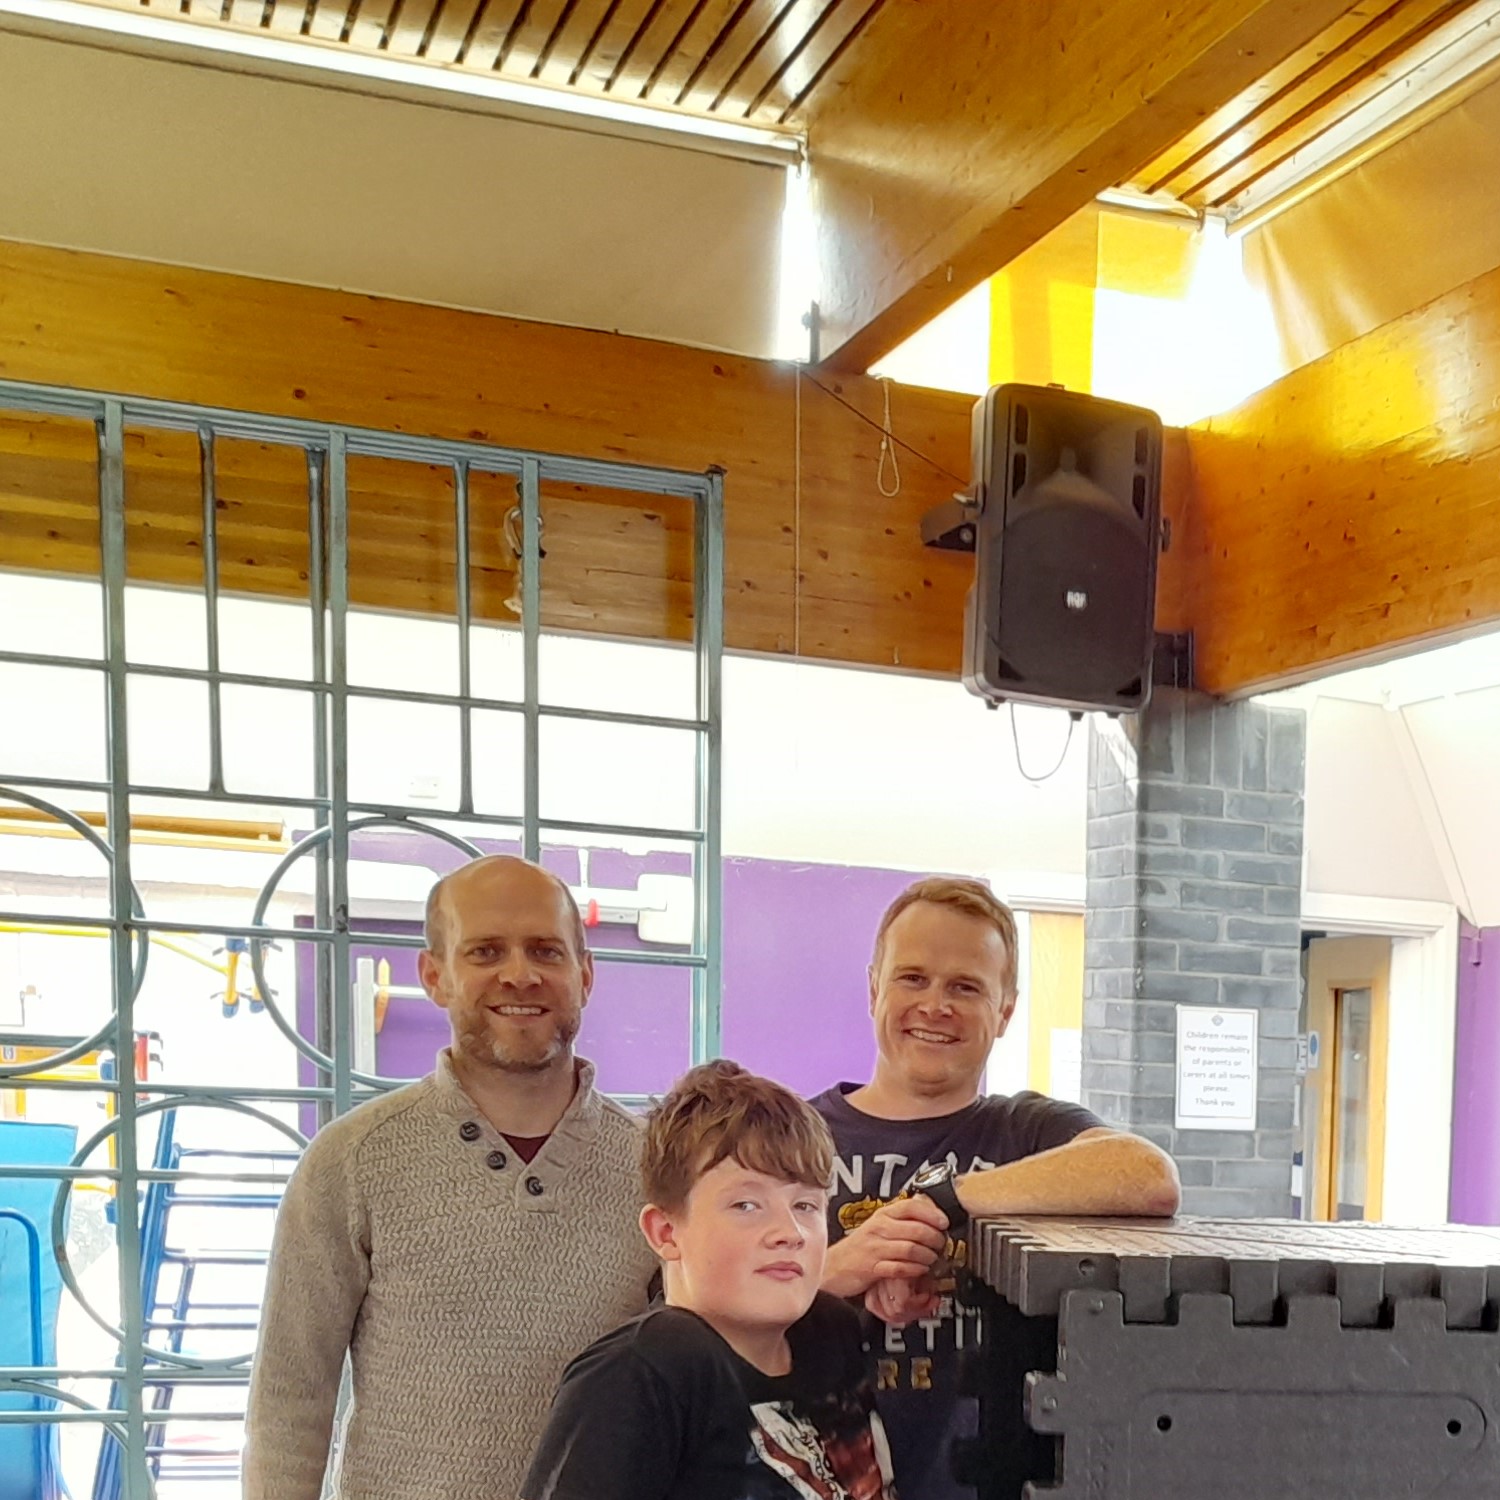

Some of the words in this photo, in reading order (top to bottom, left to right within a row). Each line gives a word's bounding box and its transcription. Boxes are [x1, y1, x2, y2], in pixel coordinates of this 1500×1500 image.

[1186, 1031, 1219, 1040] Children
[1184, 1044, 1197, 1052] the
[1199, 1045, 1250, 1054] responsibility
[1202, 1059, 1232, 1067] parents
[1229, 1072, 1251, 1080] times
[1195, 1097, 1219, 1107] Thank
[1221, 1099, 1236, 1108] you
